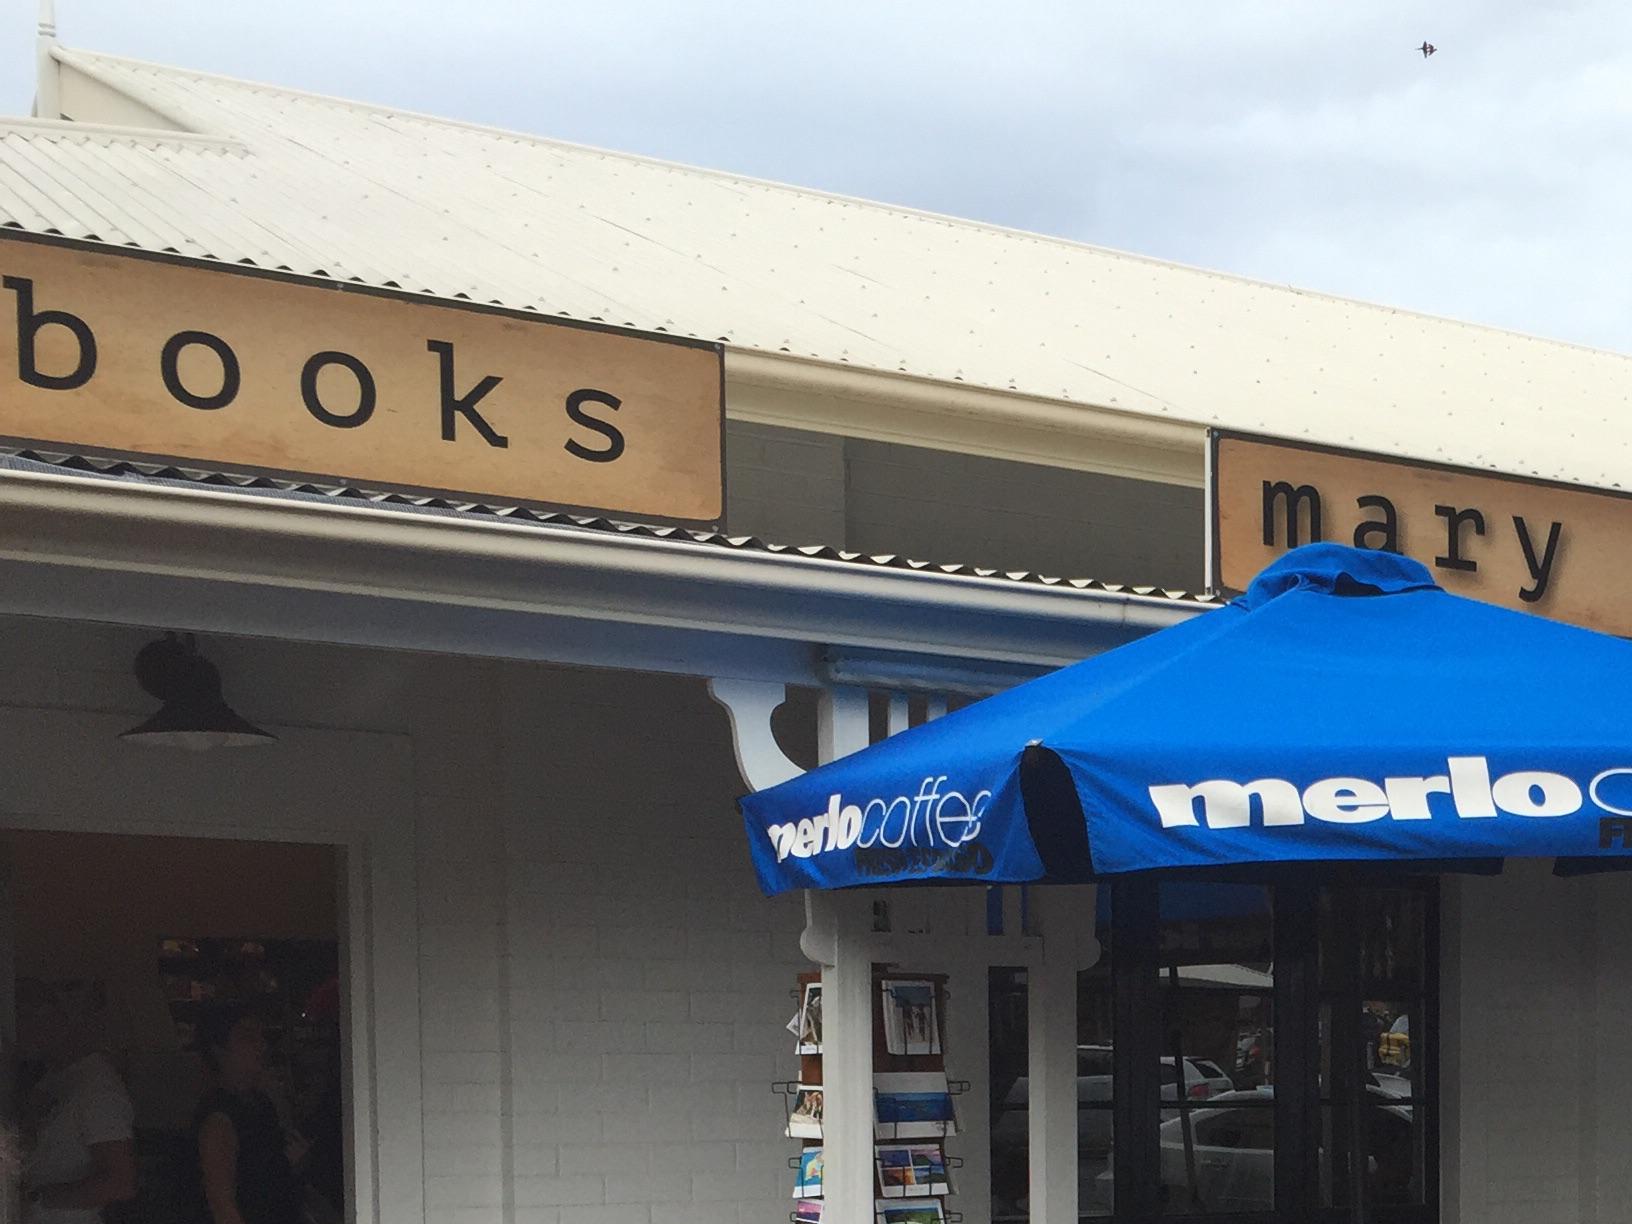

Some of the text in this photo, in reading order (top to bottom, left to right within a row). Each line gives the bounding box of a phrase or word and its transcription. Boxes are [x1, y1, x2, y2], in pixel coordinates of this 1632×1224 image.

[2, 275, 626, 463] books
[1262, 478, 1562, 602] mary
[1148, 756, 1584, 829] merlo
